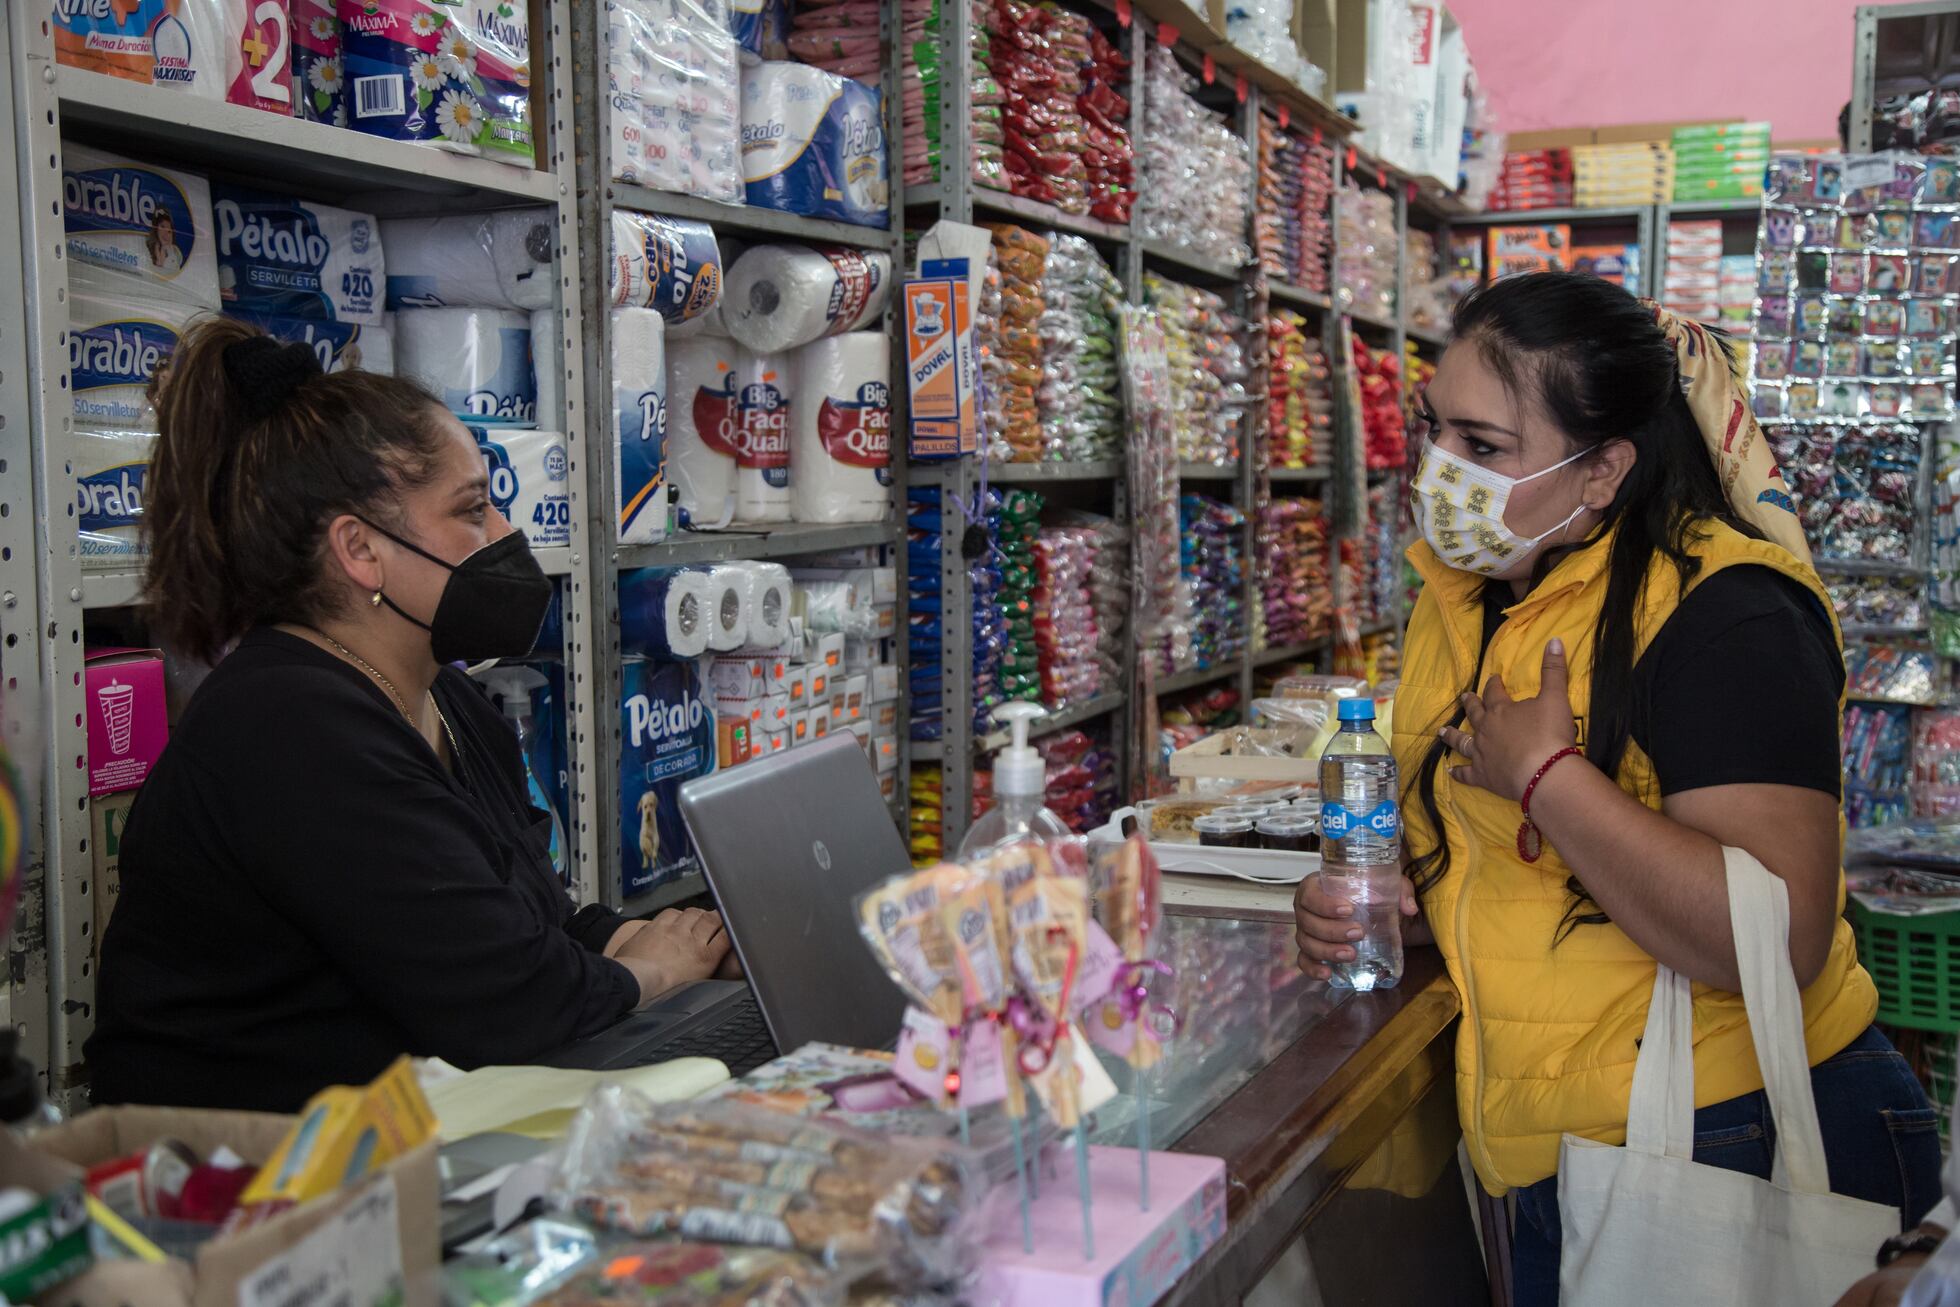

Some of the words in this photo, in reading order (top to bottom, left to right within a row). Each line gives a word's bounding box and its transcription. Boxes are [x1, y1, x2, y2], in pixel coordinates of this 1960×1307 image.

[350, 12, 398, 32] MÁXIMA
[741, 119, 784, 140] étalo
[63, 173, 156, 228] orable
[215, 200, 328, 266] Pétalo
[250, 271, 319, 289] SERVILLETA
[342, 273, 373, 298] 420
[69, 328, 160, 377] orable
[915, 349, 952, 382] DOVAL
[962, 346, 970, 389] DOVAL
[749, 386, 778, 408] Big
[864, 384, 888, 407] Big
[638, 391, 666, 441] Pé
[744, 407, 787, 429] Faci
[859, 406, 890, 428] Fac
[737, 430, 789, 457] Quali
[847, 429, 888, 457] Qua
[914, 441, 956, 451] PALILLOS
[1440, 472, 1456, 483] PRD
[77, 471, 147, 517] orab
[532, 502, 569, 525] 420
[1466, 503, 1484, 514] PRD
[1434, 518, 1450, 528] PRD
[624, 690, 703, 747] Pétalo
[654, 754, 697, 776] DECORADA
[1322, 809, 1347, 829] ciel
[1371, 808, 1397, 829] ciel
